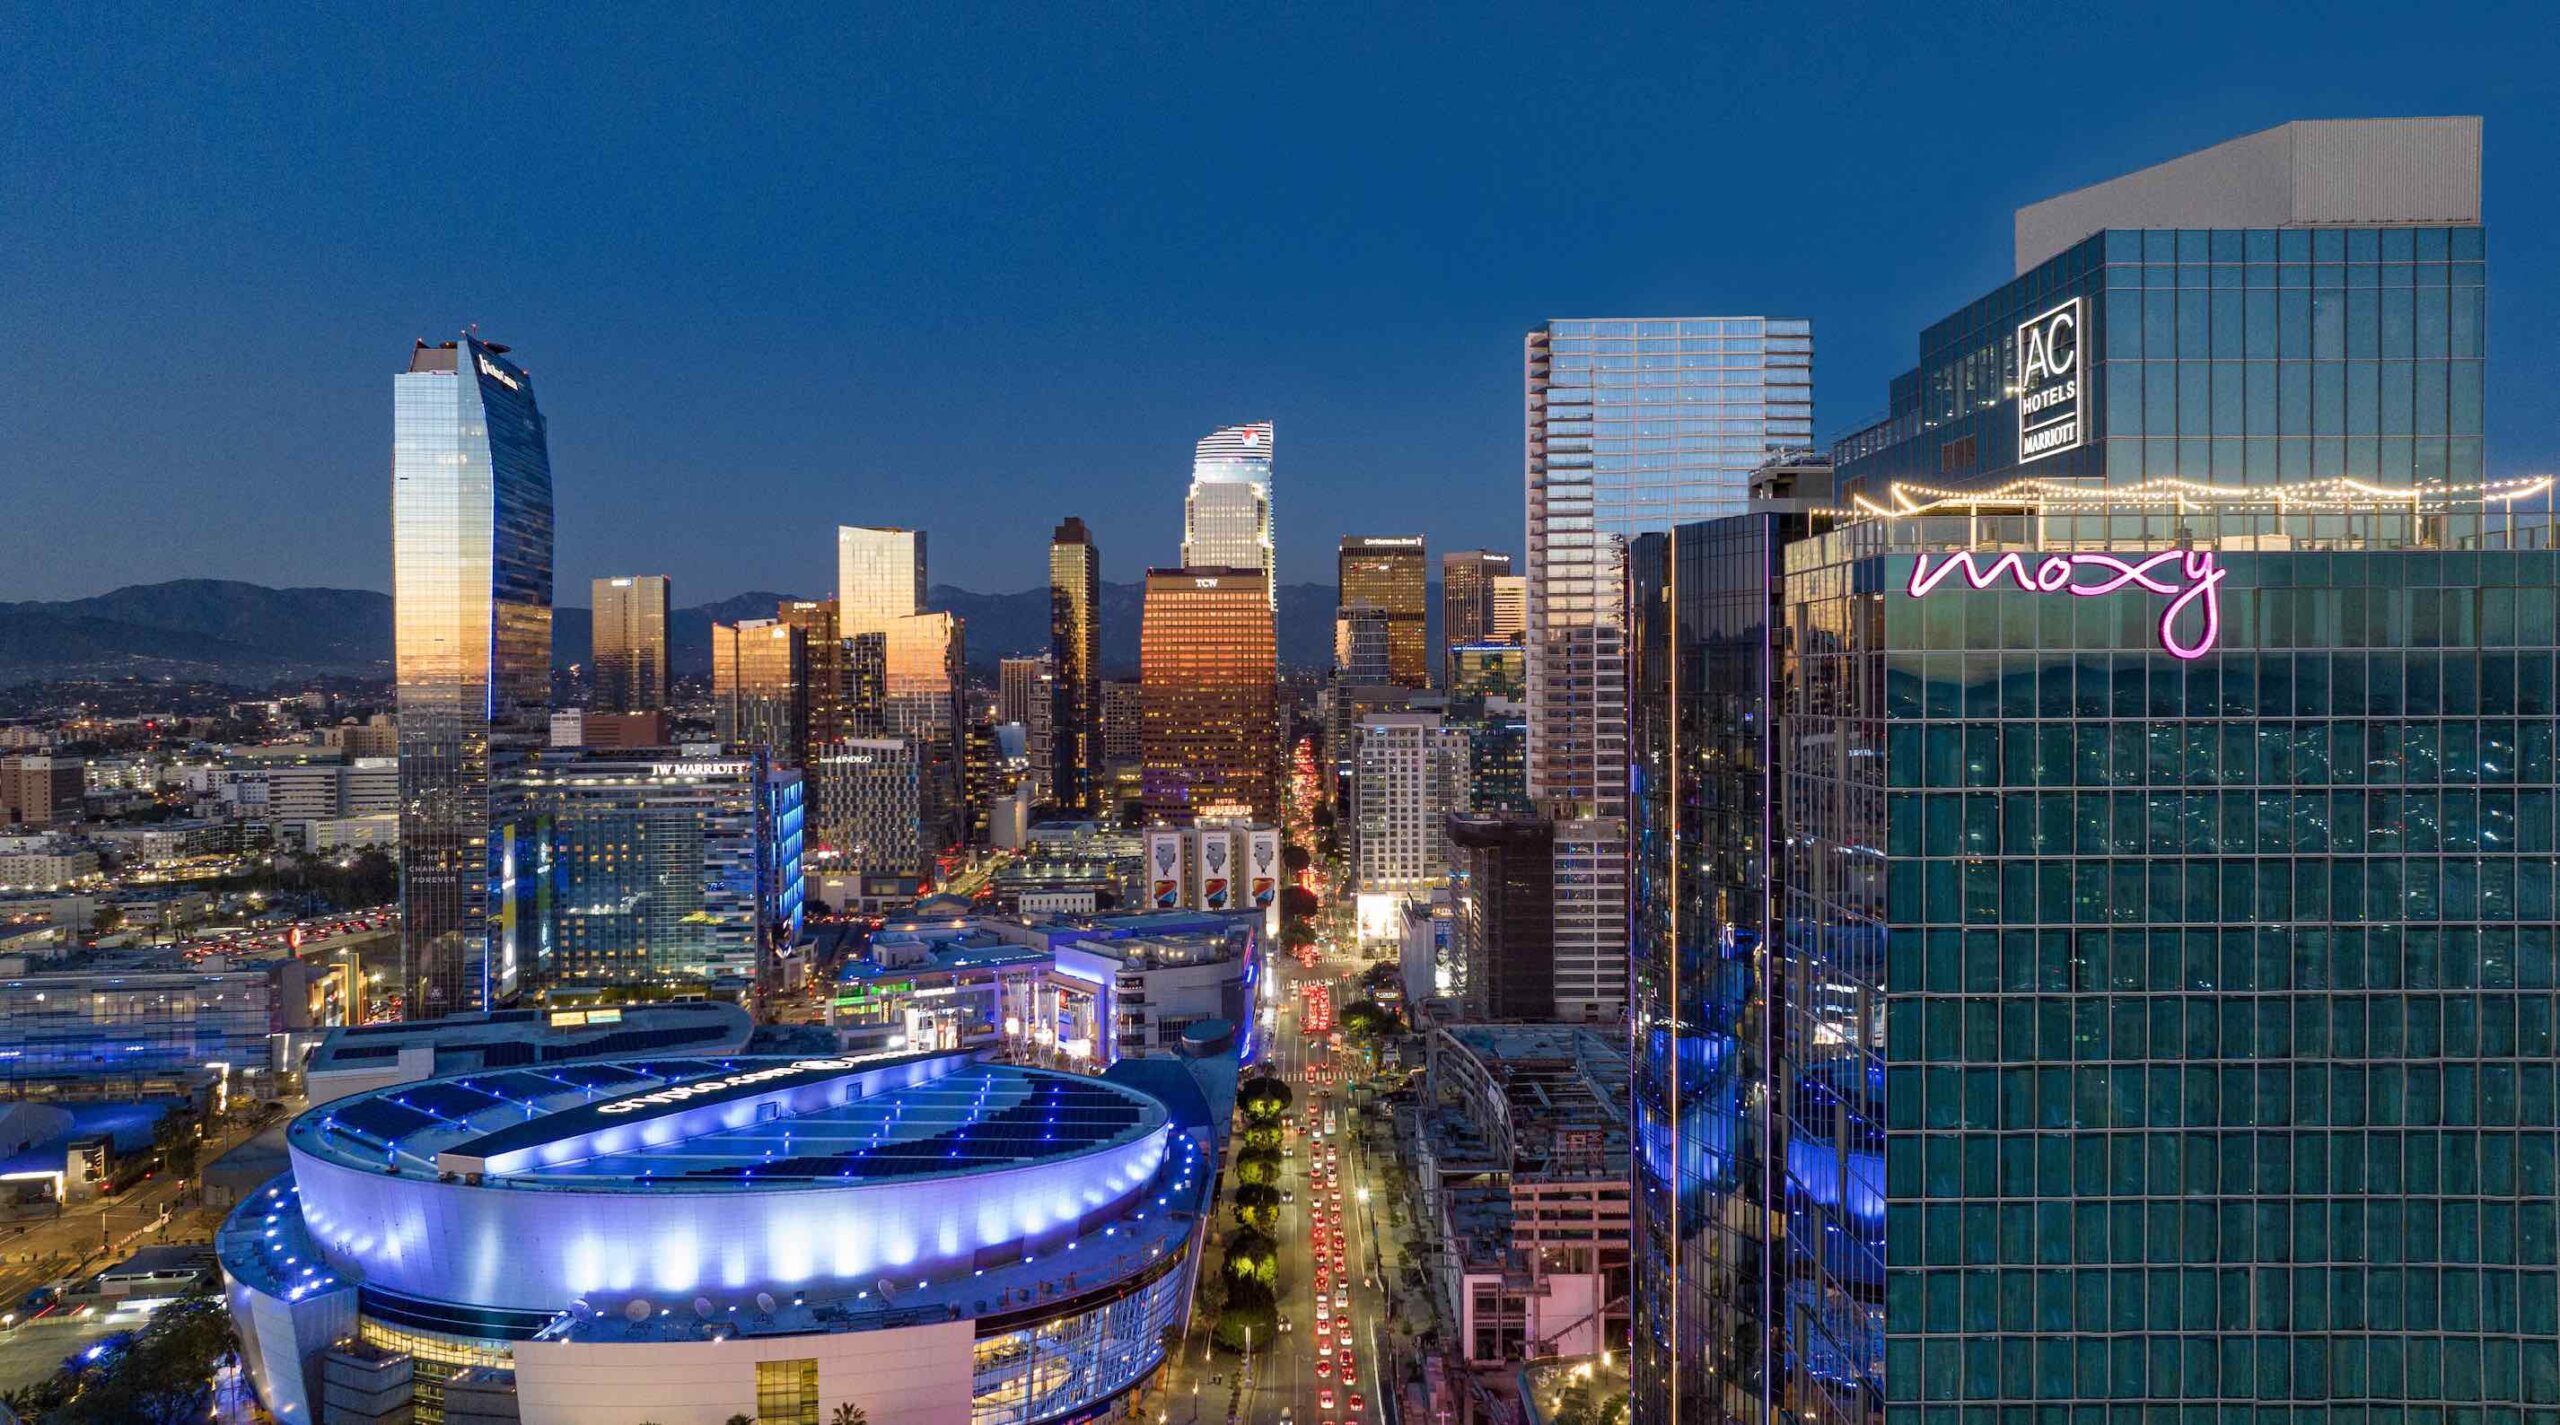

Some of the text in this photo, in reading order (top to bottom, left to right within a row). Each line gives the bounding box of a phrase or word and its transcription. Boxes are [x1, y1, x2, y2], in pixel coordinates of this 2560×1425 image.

[2023, 312, 2074, 387] AC
[2023, 380, 2076, 415] HOTELS
[2023, 422, 2076, 454] MARRIOTT
[1195, 578, 1218, 587] TCW
[1908, 550, 2226, 660] moxy
[652, 763, 745, 776] JW MARRIOTT
[842, 755, 872, 763] INDIGO
[597, 1067, 804, 1113] crypto.com
